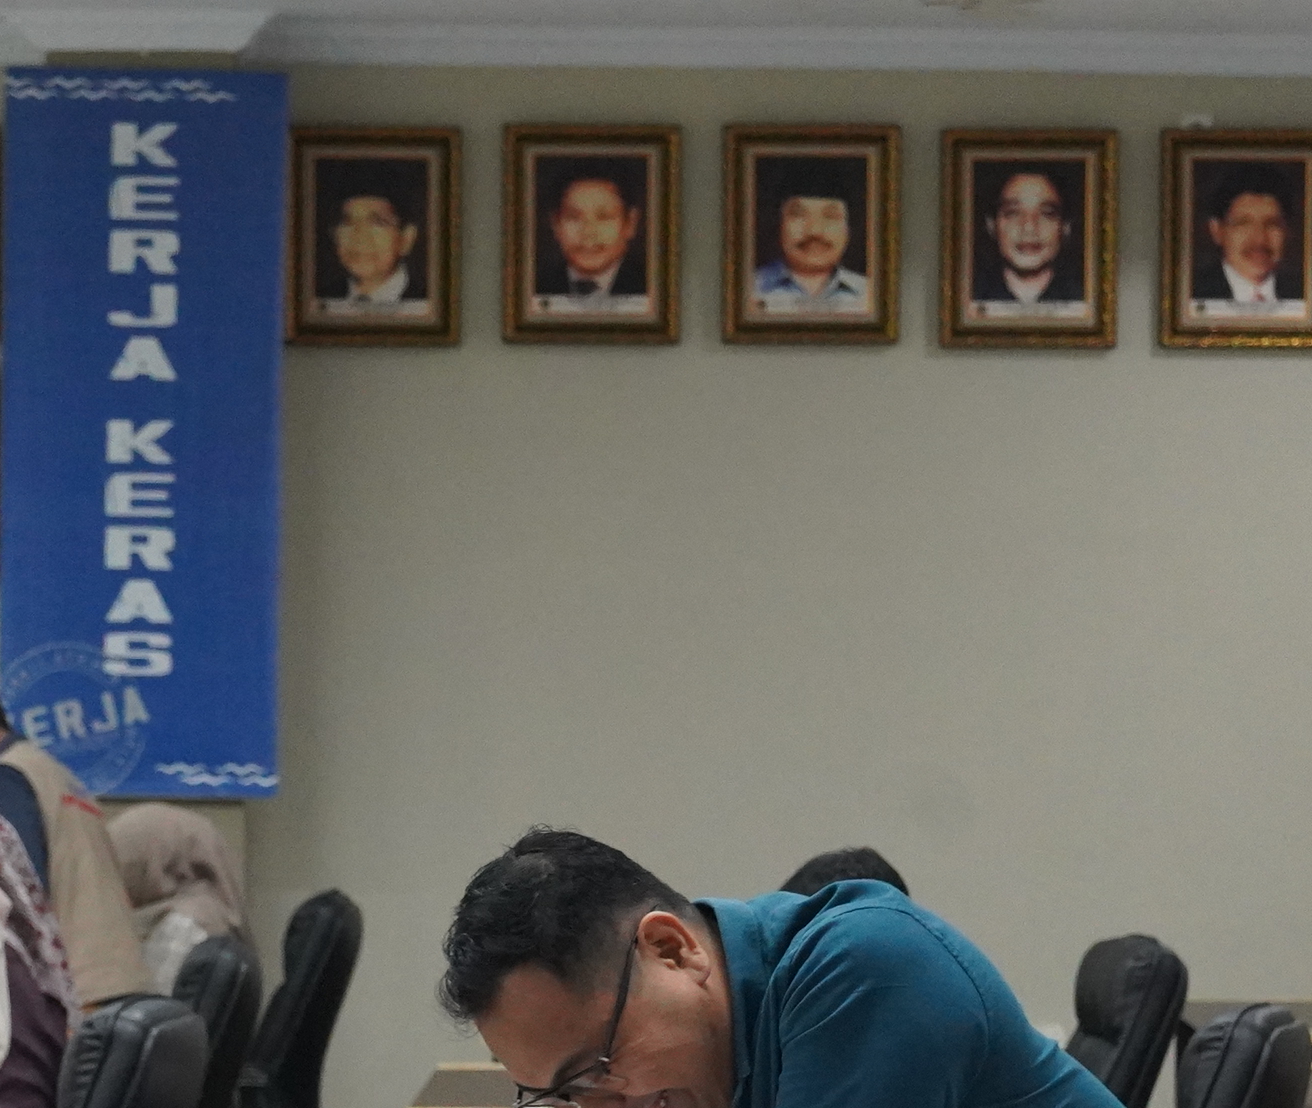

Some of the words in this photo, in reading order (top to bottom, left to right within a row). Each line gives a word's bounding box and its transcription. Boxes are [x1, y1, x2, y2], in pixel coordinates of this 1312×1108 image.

[108, 122, 180, 381] KERJA
[104, 418, 176, 677] KERAS
[7, 685, 150, 748] ERJA
